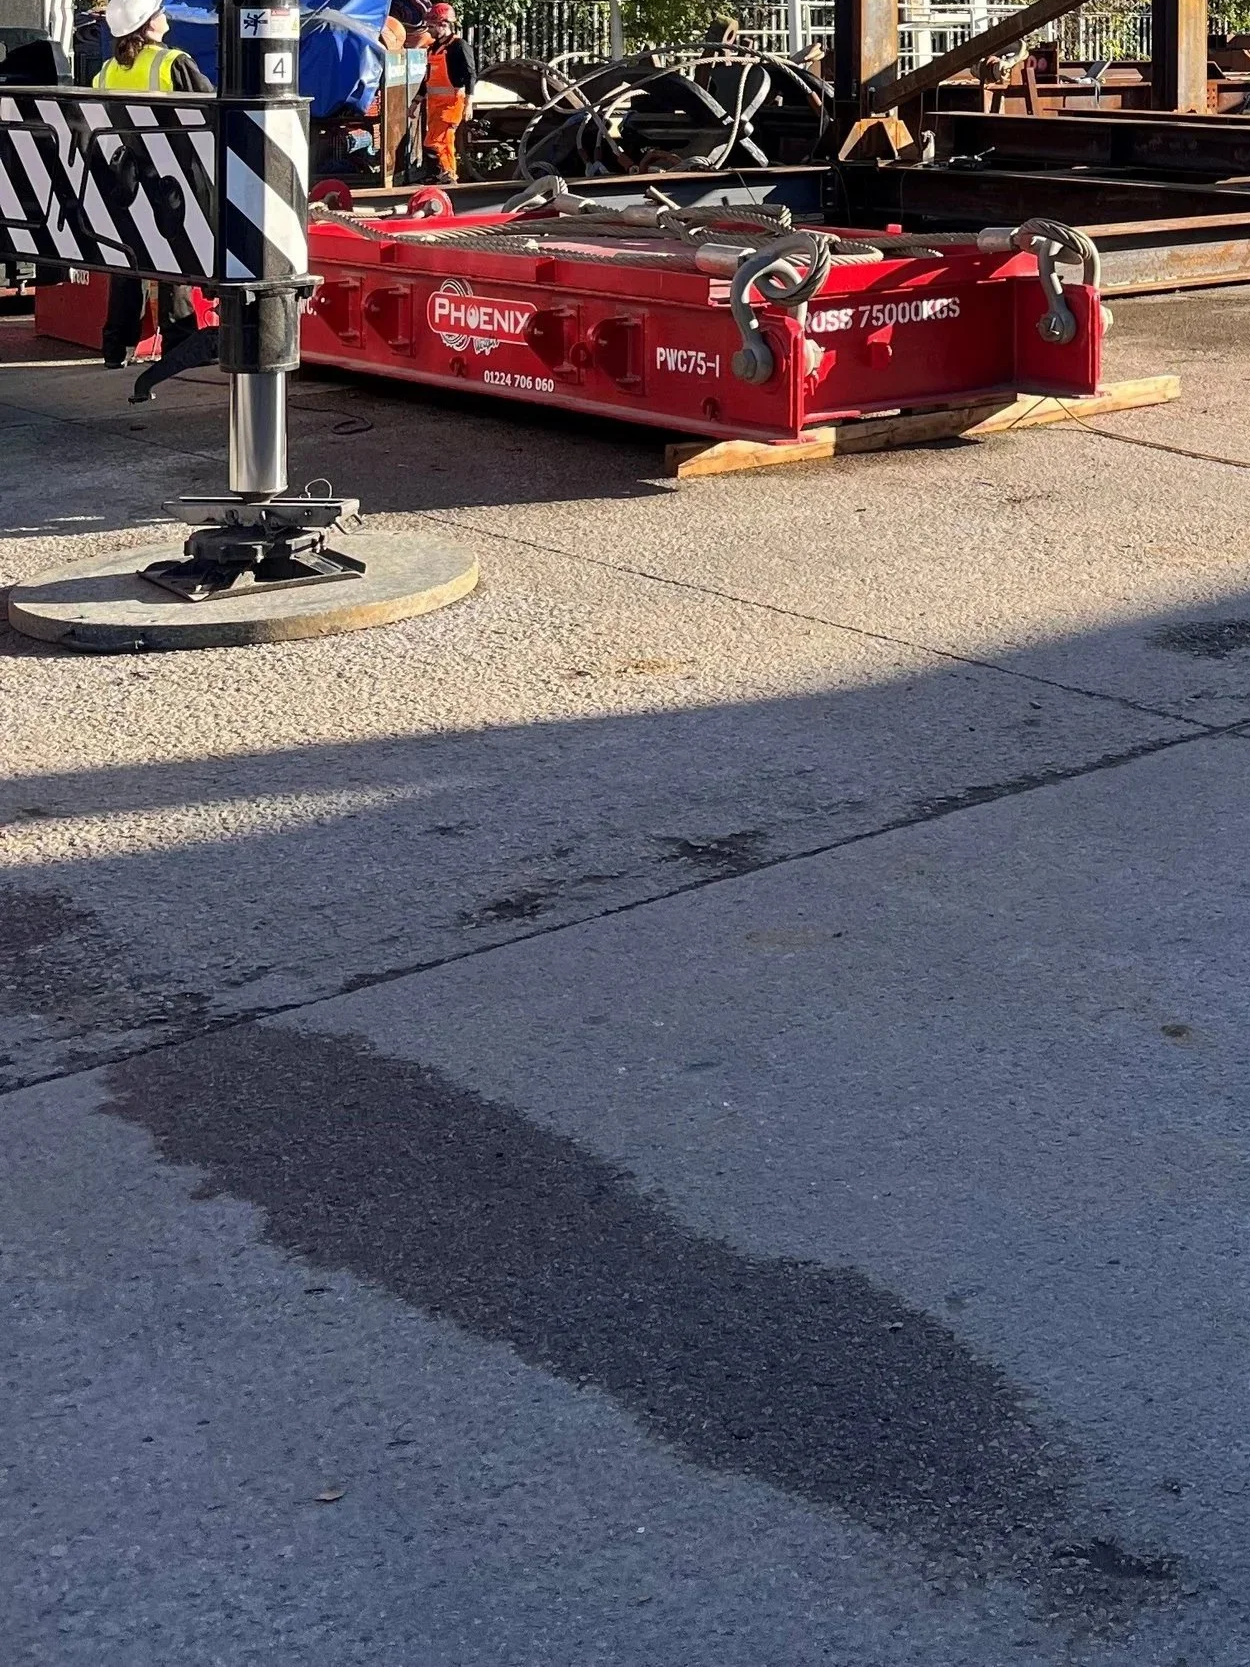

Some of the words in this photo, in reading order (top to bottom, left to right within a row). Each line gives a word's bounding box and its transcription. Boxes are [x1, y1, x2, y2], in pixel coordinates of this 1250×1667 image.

[272, 57, 286, 78] 4
[434, 297, 530, 334] PHOENIX
[858, 297, 960, 328] 75000KGS
[484, 370, 511, 386] 01224
[514, 375, 532, 389] 706
[535, 378, 554, 392] 060
